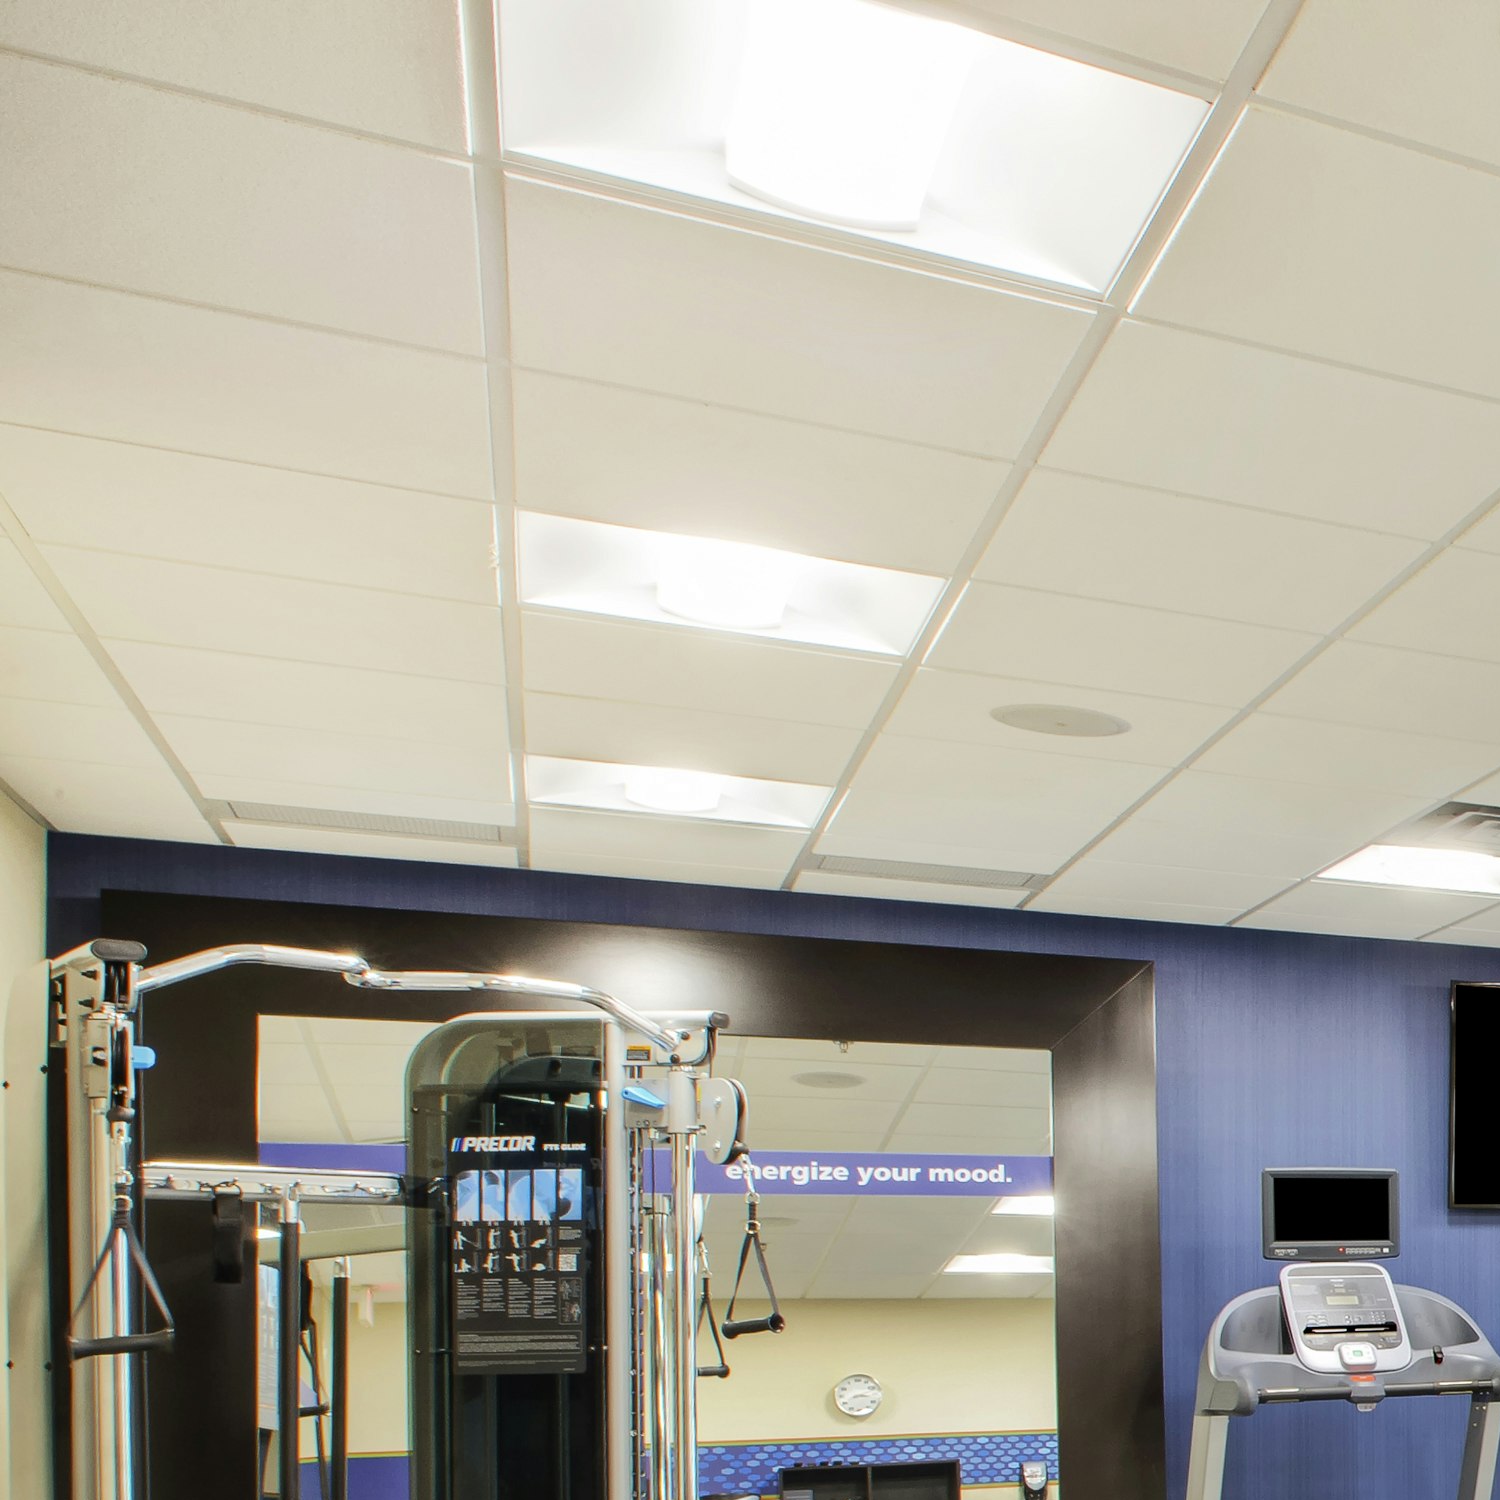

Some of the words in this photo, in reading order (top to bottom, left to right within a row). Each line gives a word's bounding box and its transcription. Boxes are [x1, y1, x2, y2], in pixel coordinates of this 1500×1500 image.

[463, 1136, 536, 1152] PRECOR
[726, 1161, 849, 1185] energize
[857, 1166, 922, 1185] your
[929, 1164, 1012, 1183] mood.
